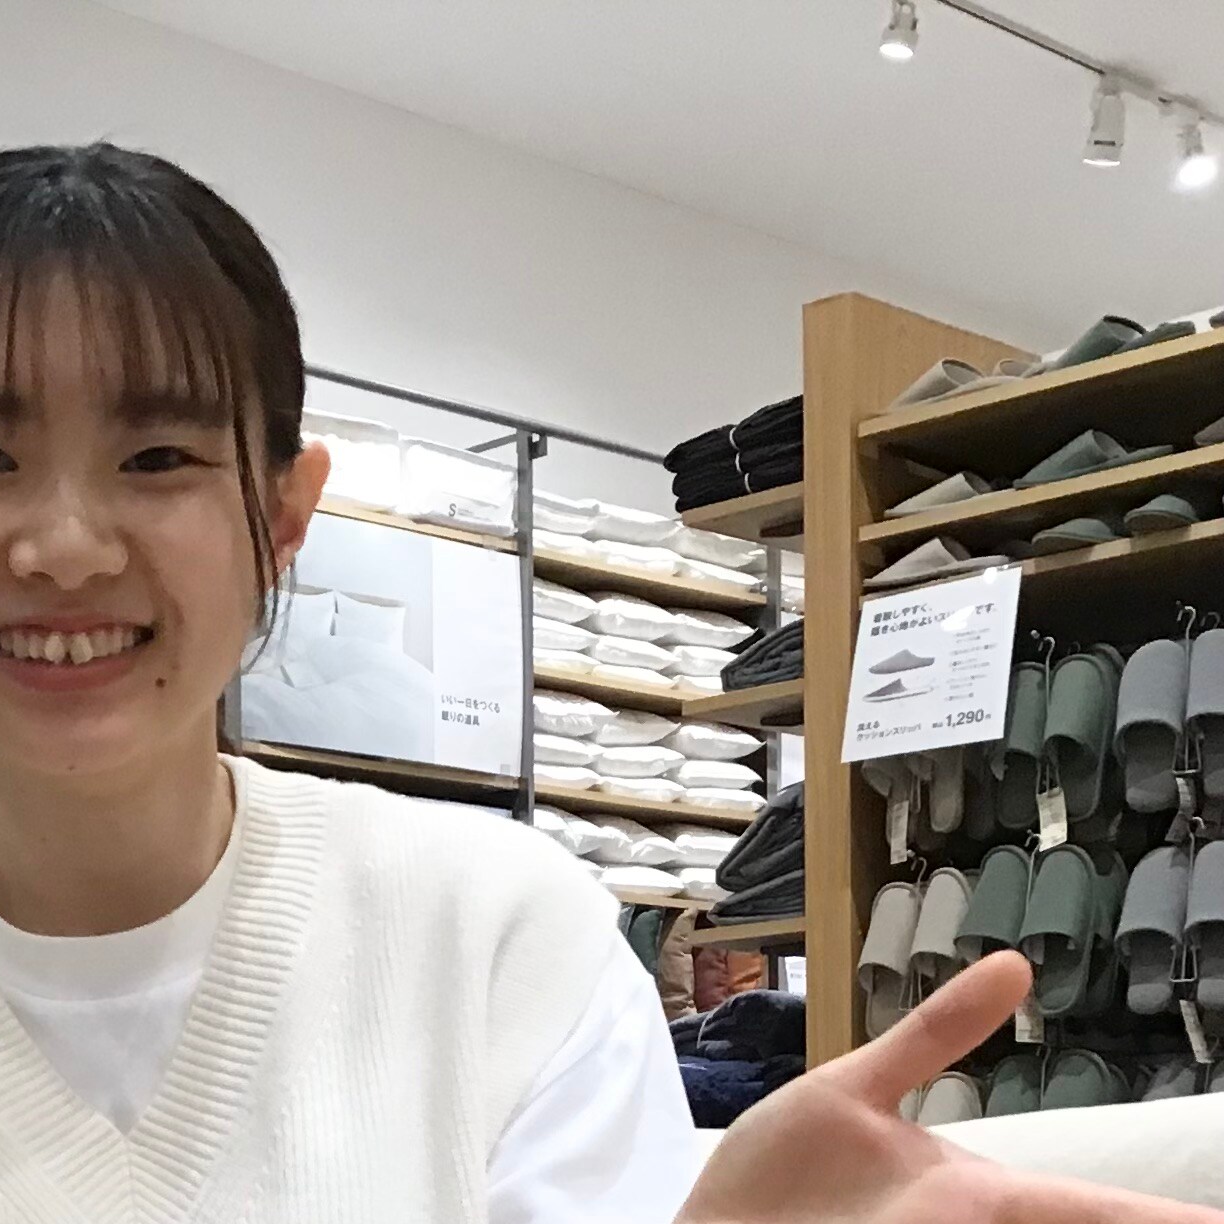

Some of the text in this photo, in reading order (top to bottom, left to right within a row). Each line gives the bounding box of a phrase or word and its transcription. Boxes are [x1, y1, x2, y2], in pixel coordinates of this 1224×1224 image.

[870, 602, 997, 637] 履き心地がよいスリです。
[441, 694, 500, 714] いい一日をつくる
